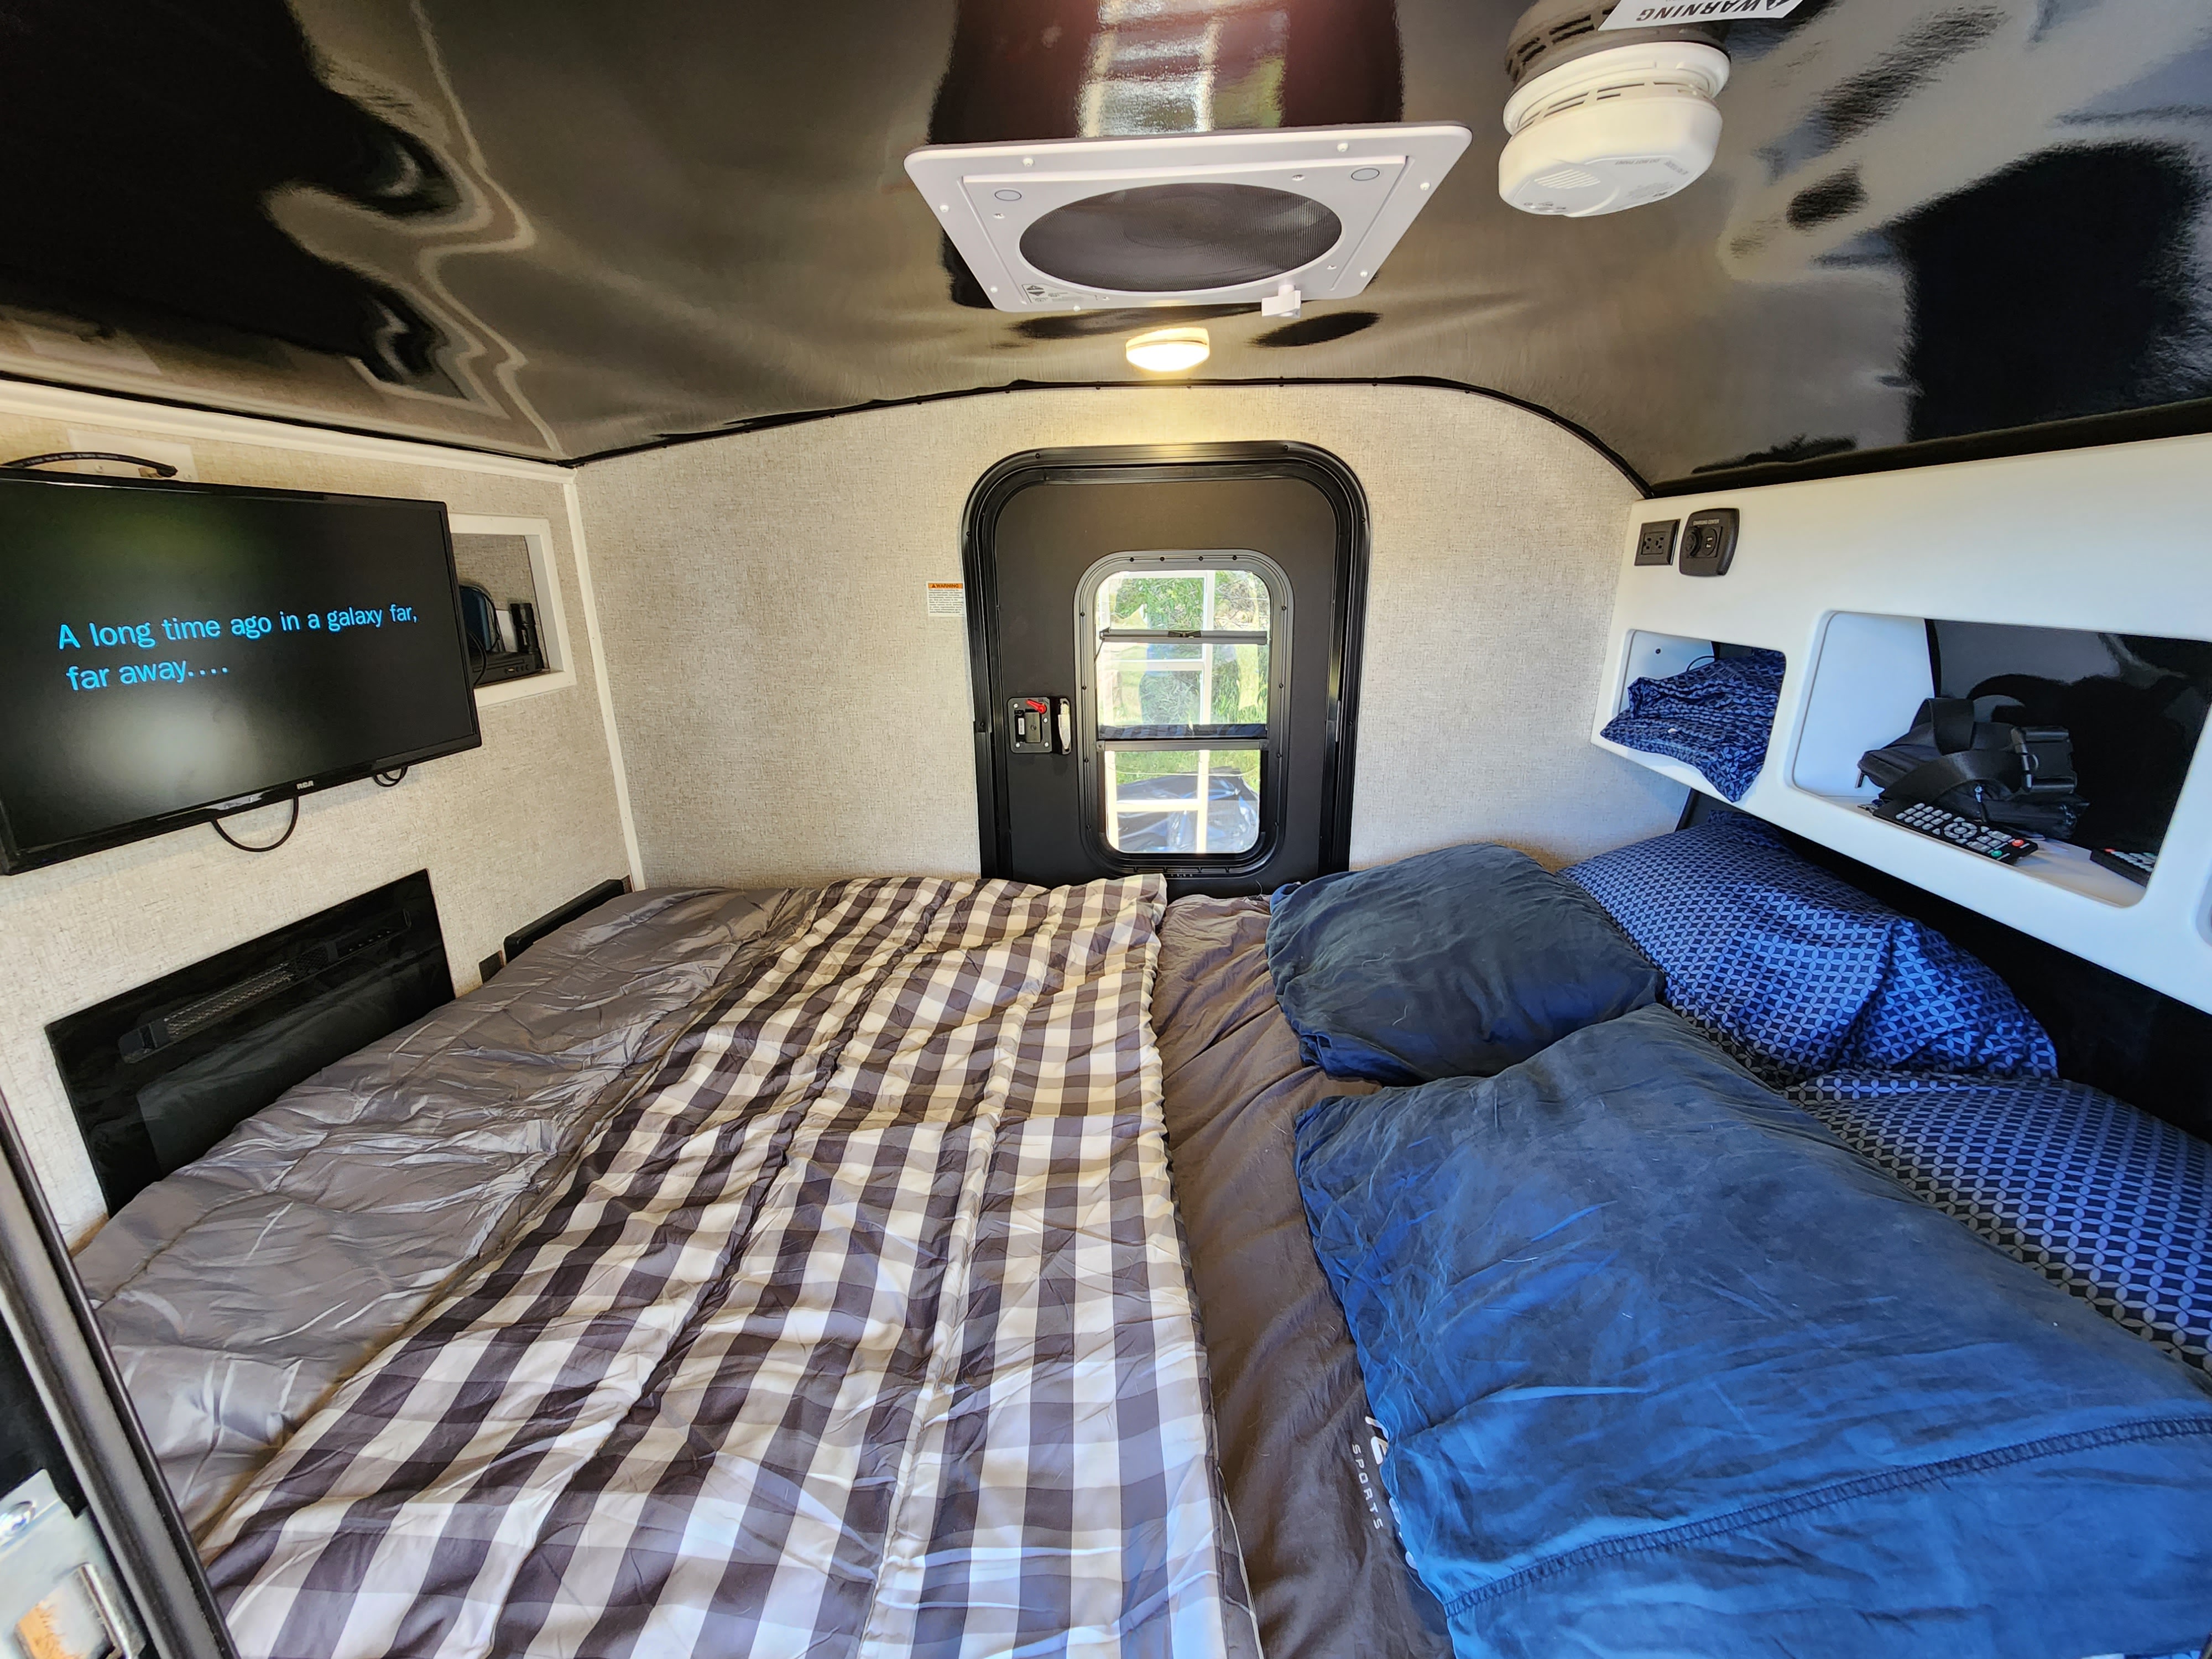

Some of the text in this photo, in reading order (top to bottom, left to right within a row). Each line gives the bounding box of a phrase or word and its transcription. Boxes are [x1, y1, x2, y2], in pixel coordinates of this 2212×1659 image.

[1636, 0, 1761, 21] WARNING
[58, 603, 418, 650] A long time ago in a galaxy far,
[65, 660, 228, 691] far away....
[296, 780, 314, 790] RCA
[1352, 1443, 1384, 1530] SPORTS
